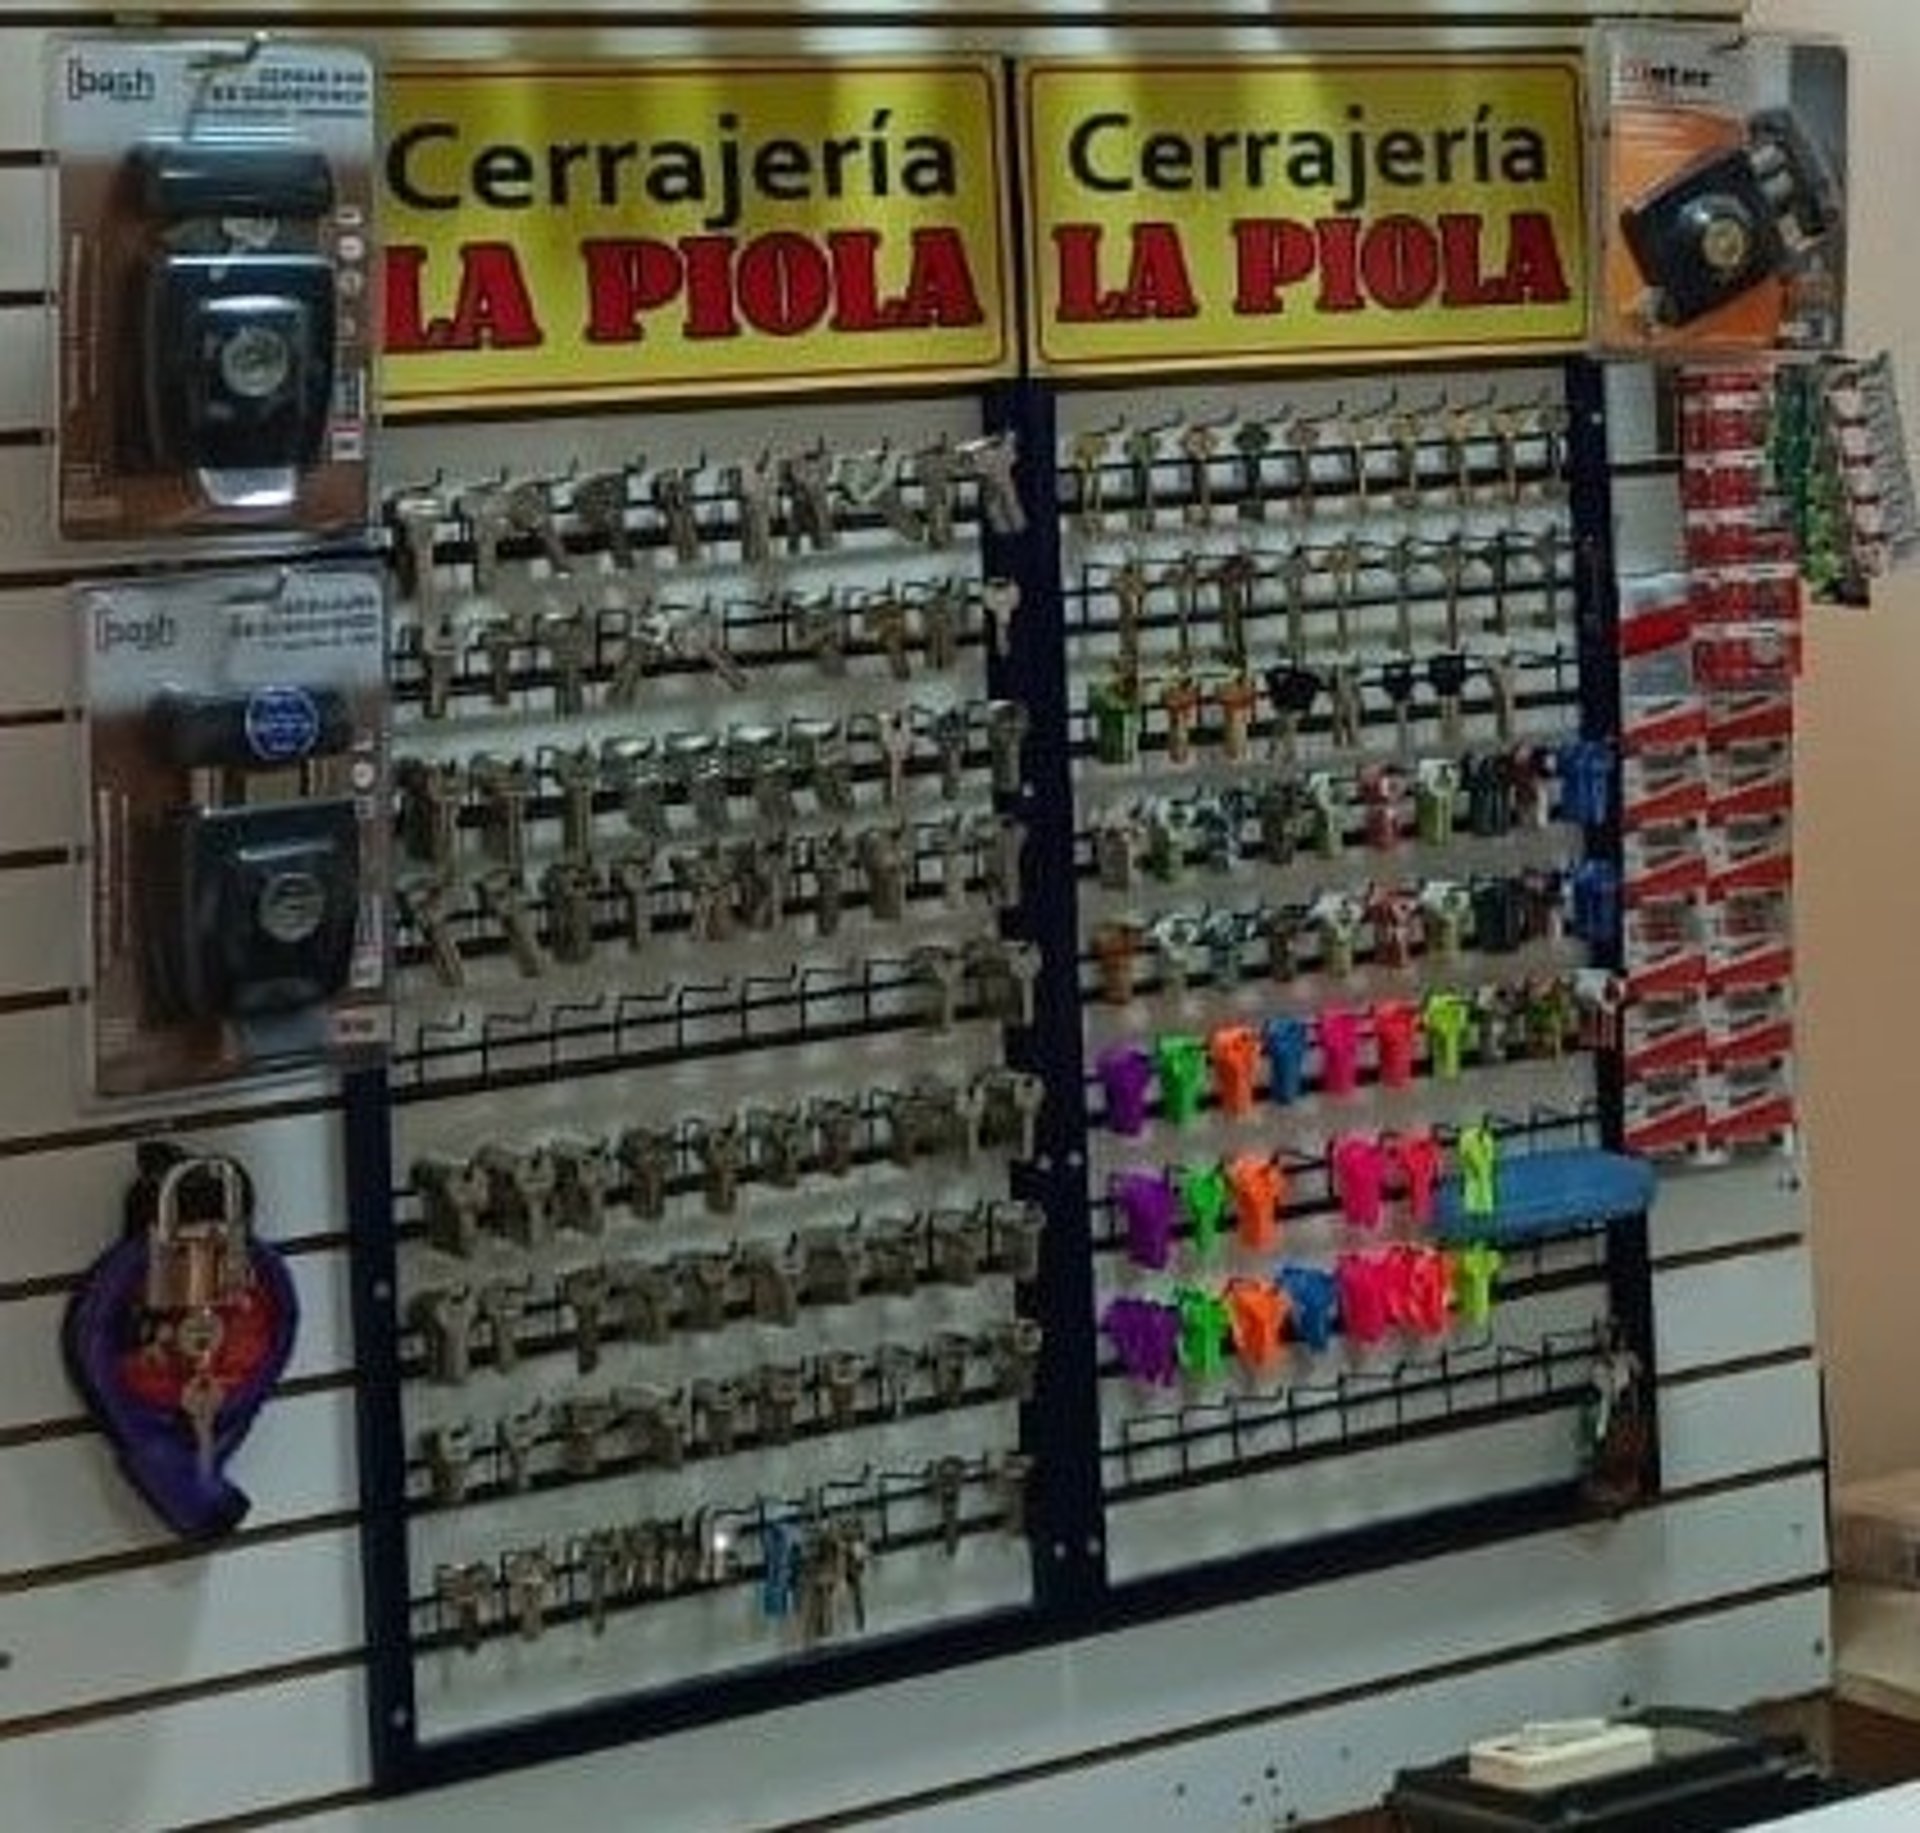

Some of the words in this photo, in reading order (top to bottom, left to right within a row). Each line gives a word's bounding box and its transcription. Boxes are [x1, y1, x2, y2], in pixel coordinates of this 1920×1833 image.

[385, 108, 956, 230] Cerrajería
[1067, 104, 1549, 210] Cerrajería
[383, 242, 543, 354] LA
[582, 227, 985, 343] PIOLA
[1052, 222, 1199, 323] LA
[1231, 212, 1571, 316] PIOLA
